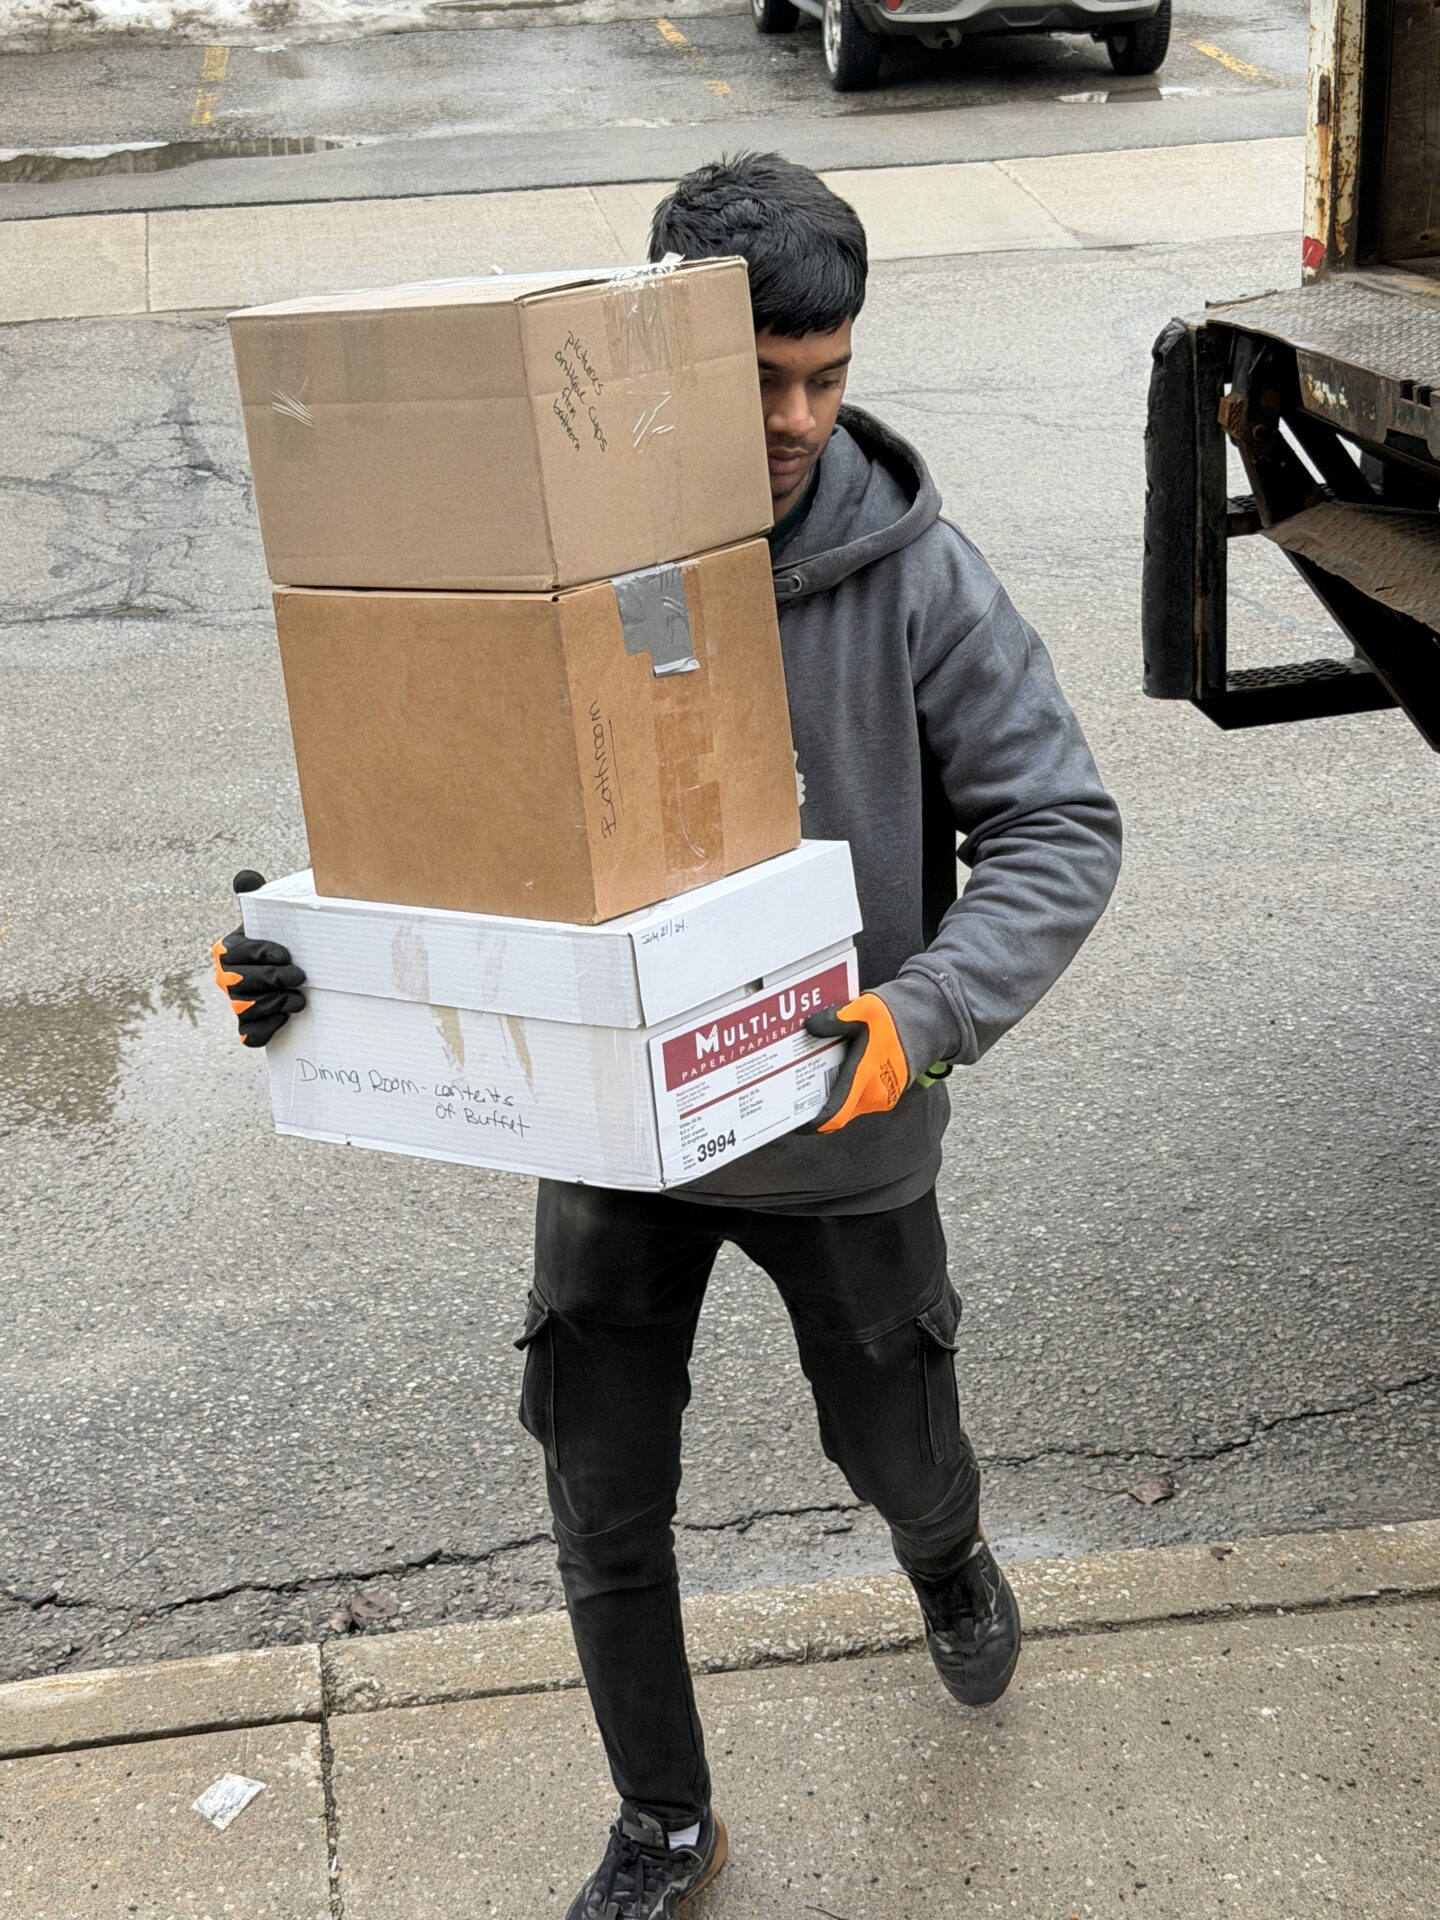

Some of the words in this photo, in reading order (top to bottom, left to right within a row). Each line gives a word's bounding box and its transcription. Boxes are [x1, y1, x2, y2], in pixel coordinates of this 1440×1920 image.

[563, 330, 604, 396] pictures
[589, 700, 617, 839] Bathroom
[295, 1058, 362, 1093] Dining
[696, 1129, 737, 1163] 3994
